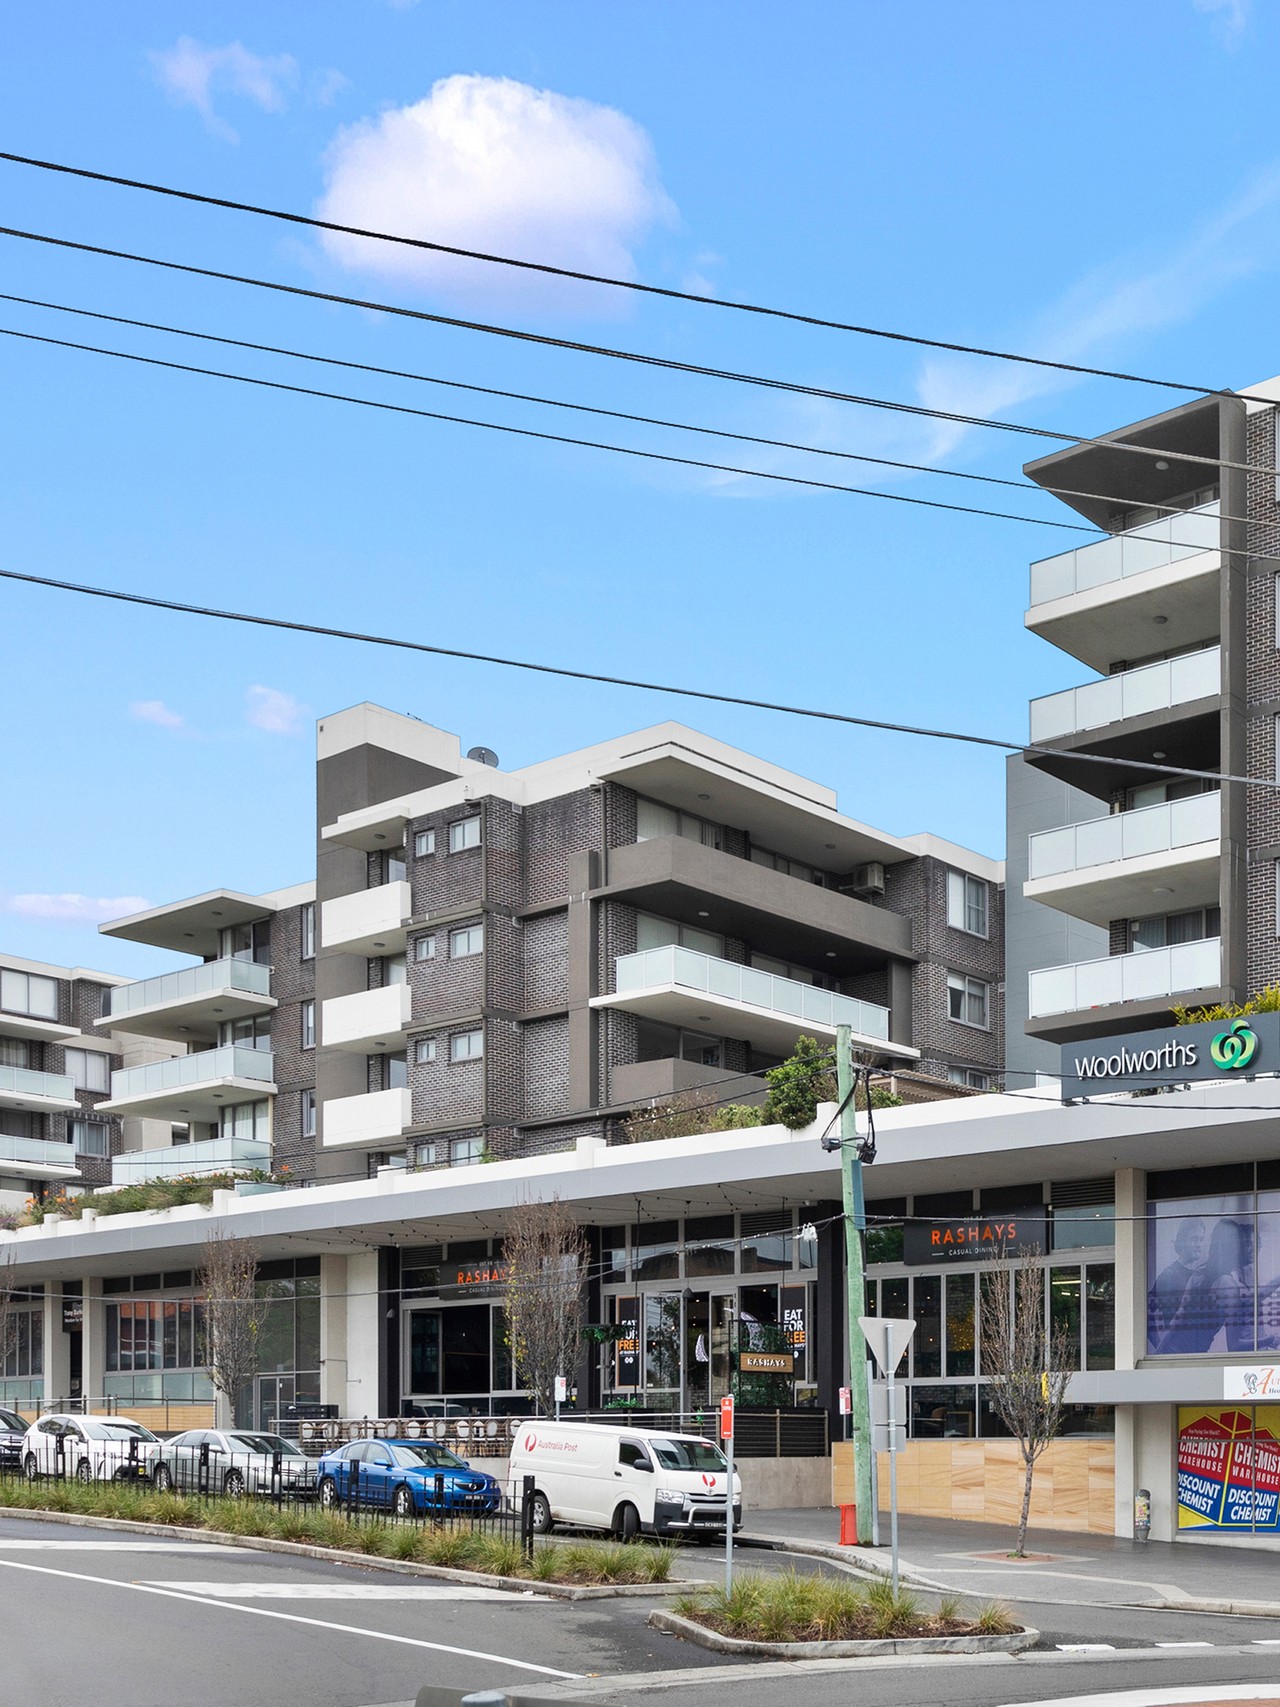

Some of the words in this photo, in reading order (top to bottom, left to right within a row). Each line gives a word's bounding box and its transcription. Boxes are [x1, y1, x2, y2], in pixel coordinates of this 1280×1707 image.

[1075, 1040, 1197, 1080] Woolworths
[931, 1223, 1017, 1245] RASHAYS
[948, 1247, 972, 1256] CASUAL
[457, 1266, 510, 1285] RASHAY
[784, 1309, 803, 1320] EAT
[783, 1320, 804, 1331] FOR
[618, 1339, 640, 1350] FREE
[537, 1439, 563, 1451] Australia
[564, 1442, 578, 1451] Post
[1180, 1436, 1227, 1459] CHEMIST
[1178, 1454, 1222, 1472] WAREHOUSE
[1232, 1466, 1279, 1486] WARHOUSE
[1228, 1489, 1277, 1507] DISCOUNT
[1231, 1506, 1272, 1522] CHEMIST
